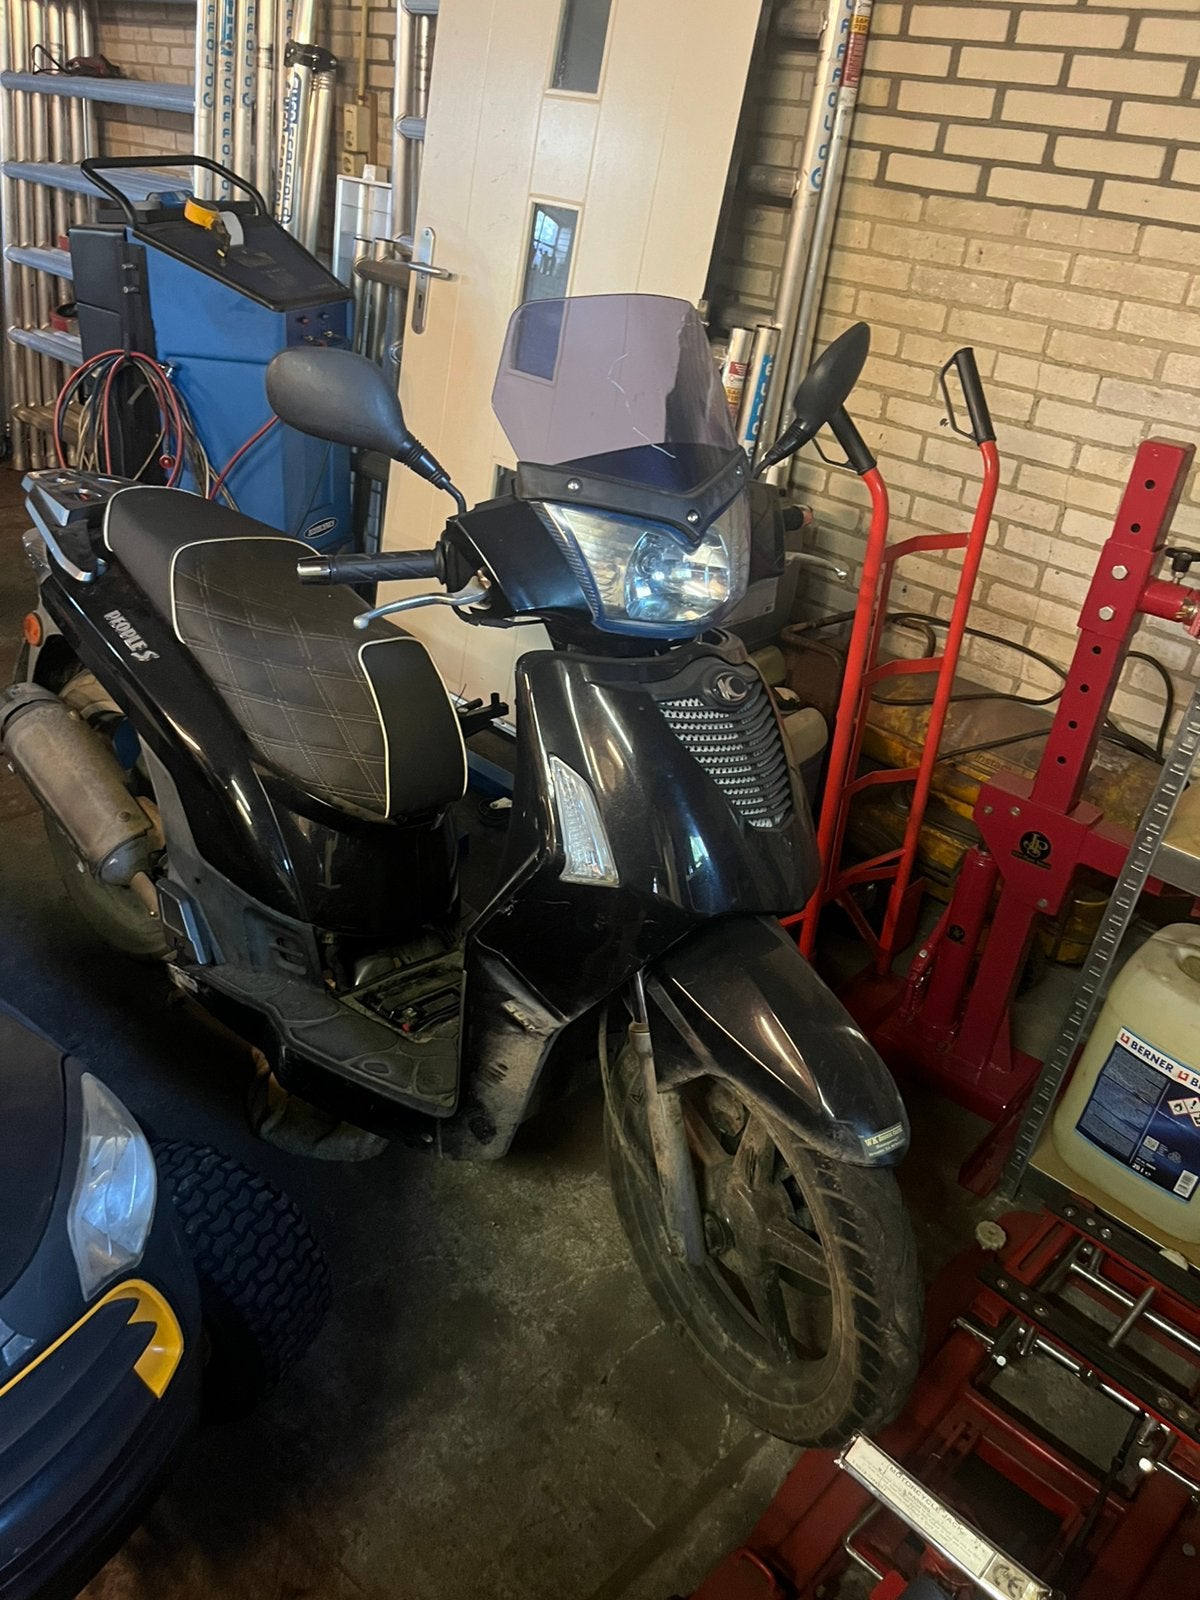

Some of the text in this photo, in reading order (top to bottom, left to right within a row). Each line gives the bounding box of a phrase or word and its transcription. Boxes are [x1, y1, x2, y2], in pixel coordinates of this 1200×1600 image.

[103, 609, 148, 652] PEOPLE
[1130, 1040, 1174, 1073] BERNER
[888, 1465, 942, 1514] MOTORCYCLE
